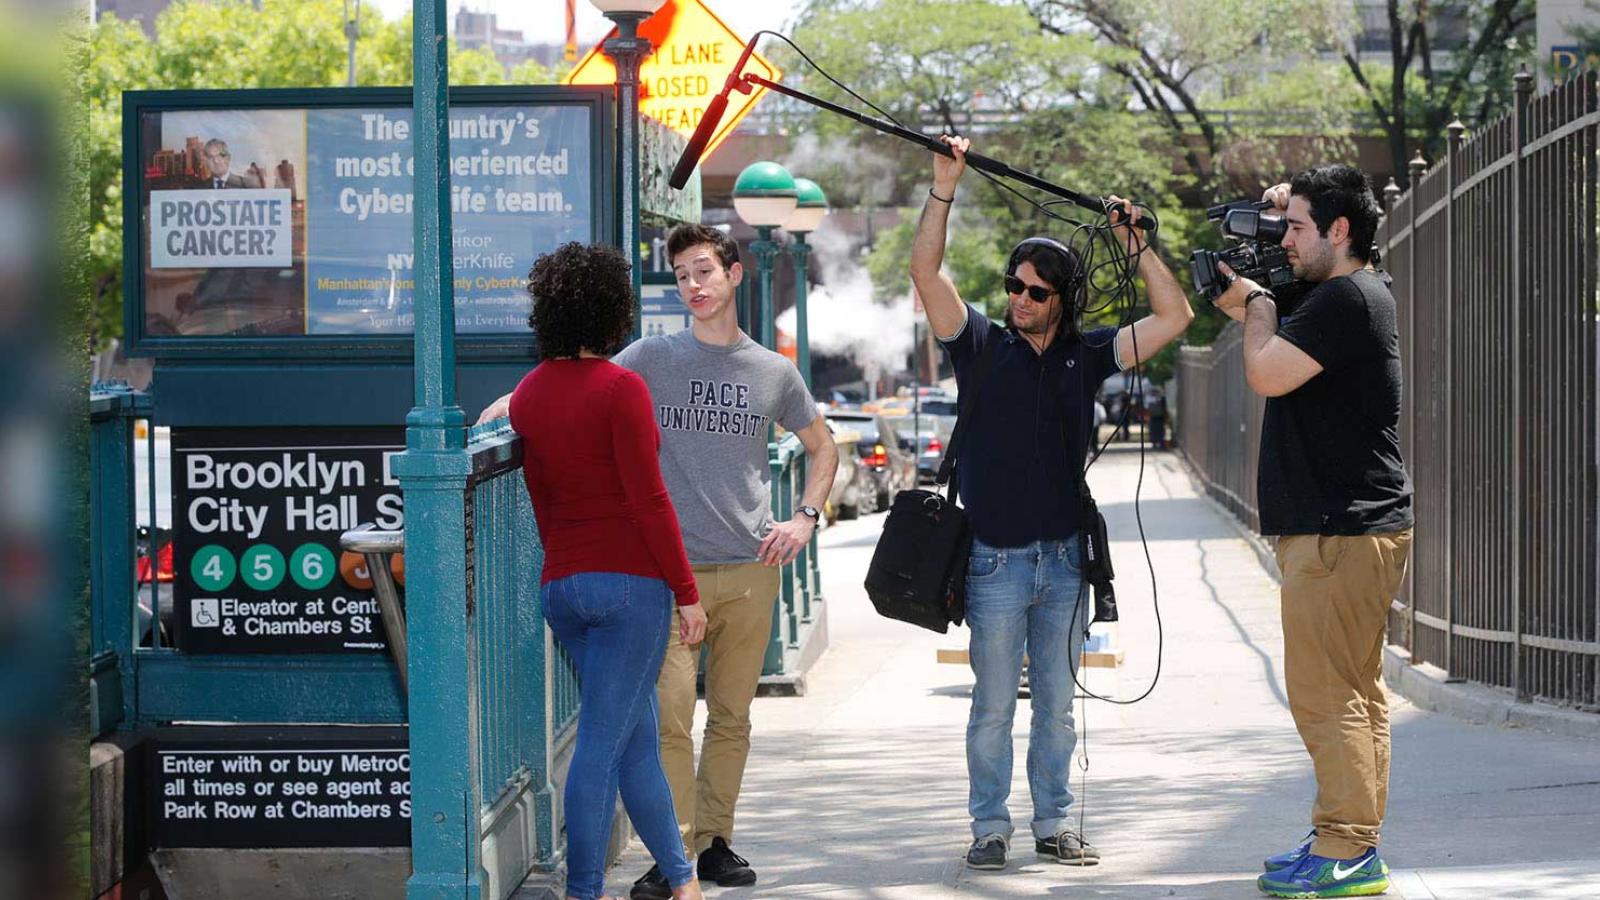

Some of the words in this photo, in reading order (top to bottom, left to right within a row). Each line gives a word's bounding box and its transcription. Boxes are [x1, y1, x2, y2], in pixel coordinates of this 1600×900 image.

[671, 43, 723, 65] LANE
[640, 75, 708, 97] LOSED
[361, 113, 410, 141] The
[449, 112, 541, 145] untry's
[651, 107, 704, 129] HEAD
[335, 152, 402, 177] most
[406, 149, 569, 177] erienced
[160, 200, 282, 227] PROSTATE
[339, 186, 488, 221] Cyberife
[495, 189, 573, 213] team.
[166, 229, 277, 257] CANCER?
[476, 314, 529, 328] Everythin
[688, 380, 750, 409] PACE
[187, 453, 364, 494] Brooklyn
[189, 497, 268, 538] City
[286, 495, 359, 531] Hall
[202, 555, 224, 581] 4
[252, 554, 274, 581] 5
[302, 553, 324, 580] 6
[222, 599, 297, 615] Elevator
[306, 599, 324, 614] at
[331, 596, 381, 615] Cent
[223, 618, 236, 635] &
[245, 618, 342, 635] Chambers
[351, 616, 371, 633] St
[164, 756, 213, 772] Enter
[222, 756, 261, 772] with
[270, 760, 290, 772] or
[298, 755, 333, 775] buy
[165, 779, 184, 795] all
[193, 779, 245, 795] times
[254, 783, 274, 795] or
[283, 782, 318, 795] see
[327, 779, 382, 798] agent
[165, 802, 206, 818] Park
[215, 802, 256, 818] Row
[265, 802, 283, 818] at
[292, 801, 391, 818] Chambers
[399, 800, 412, 818] S
